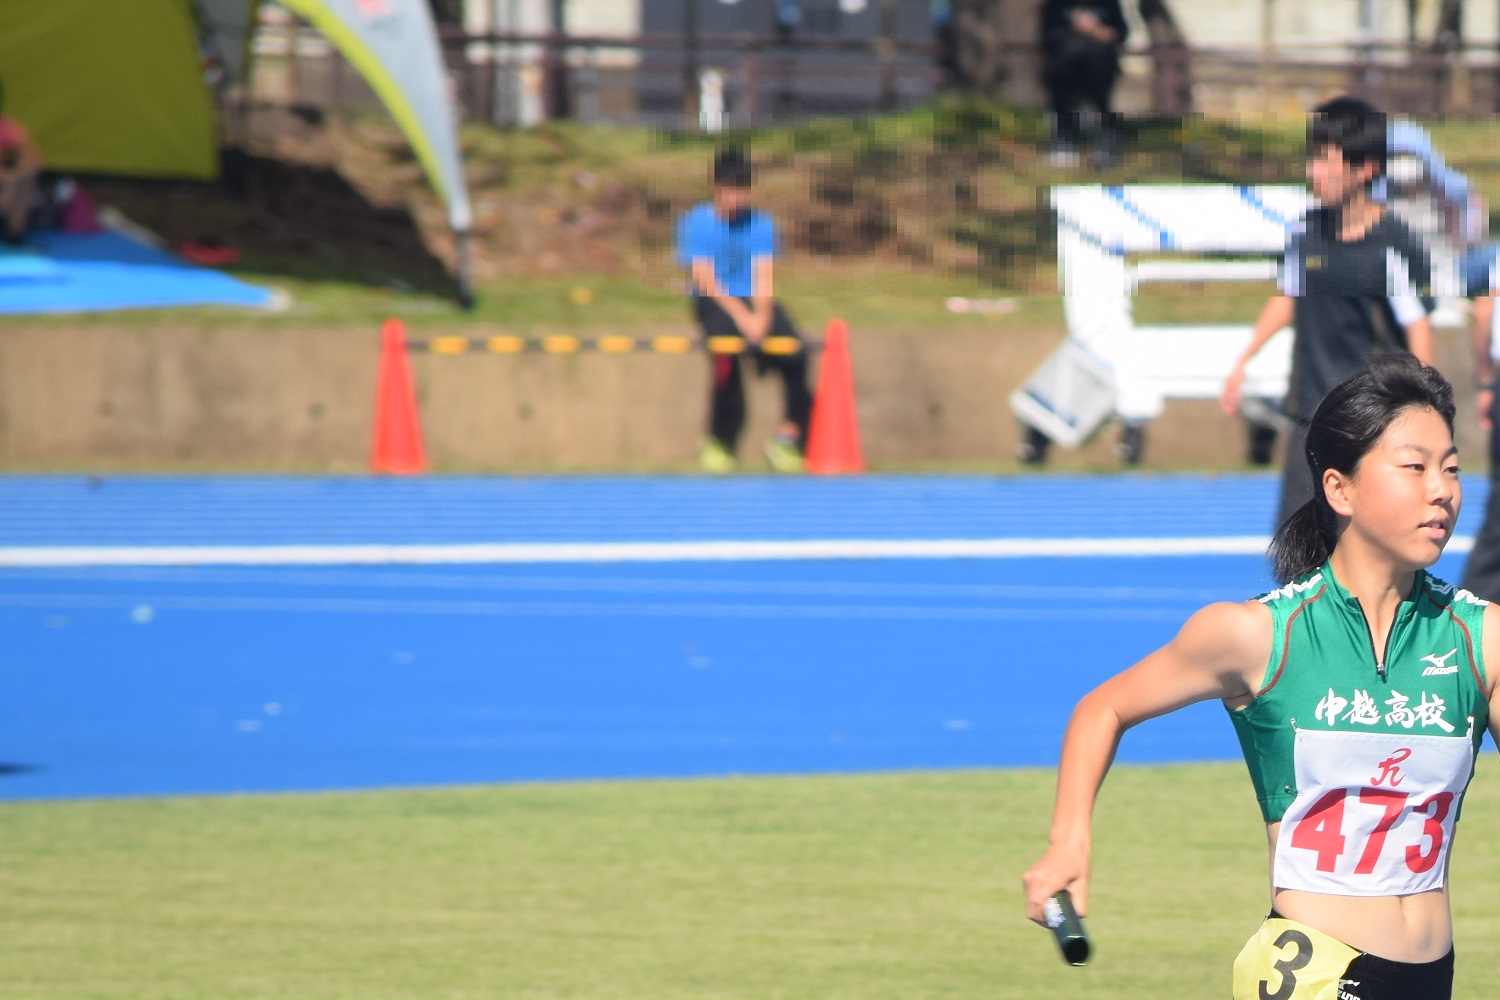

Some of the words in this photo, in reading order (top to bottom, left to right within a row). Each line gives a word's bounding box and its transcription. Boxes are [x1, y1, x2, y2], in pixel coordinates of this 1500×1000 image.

[1315, 687, 1456, 733] 中越高校
[1291, 787, 1454, 874] 473
